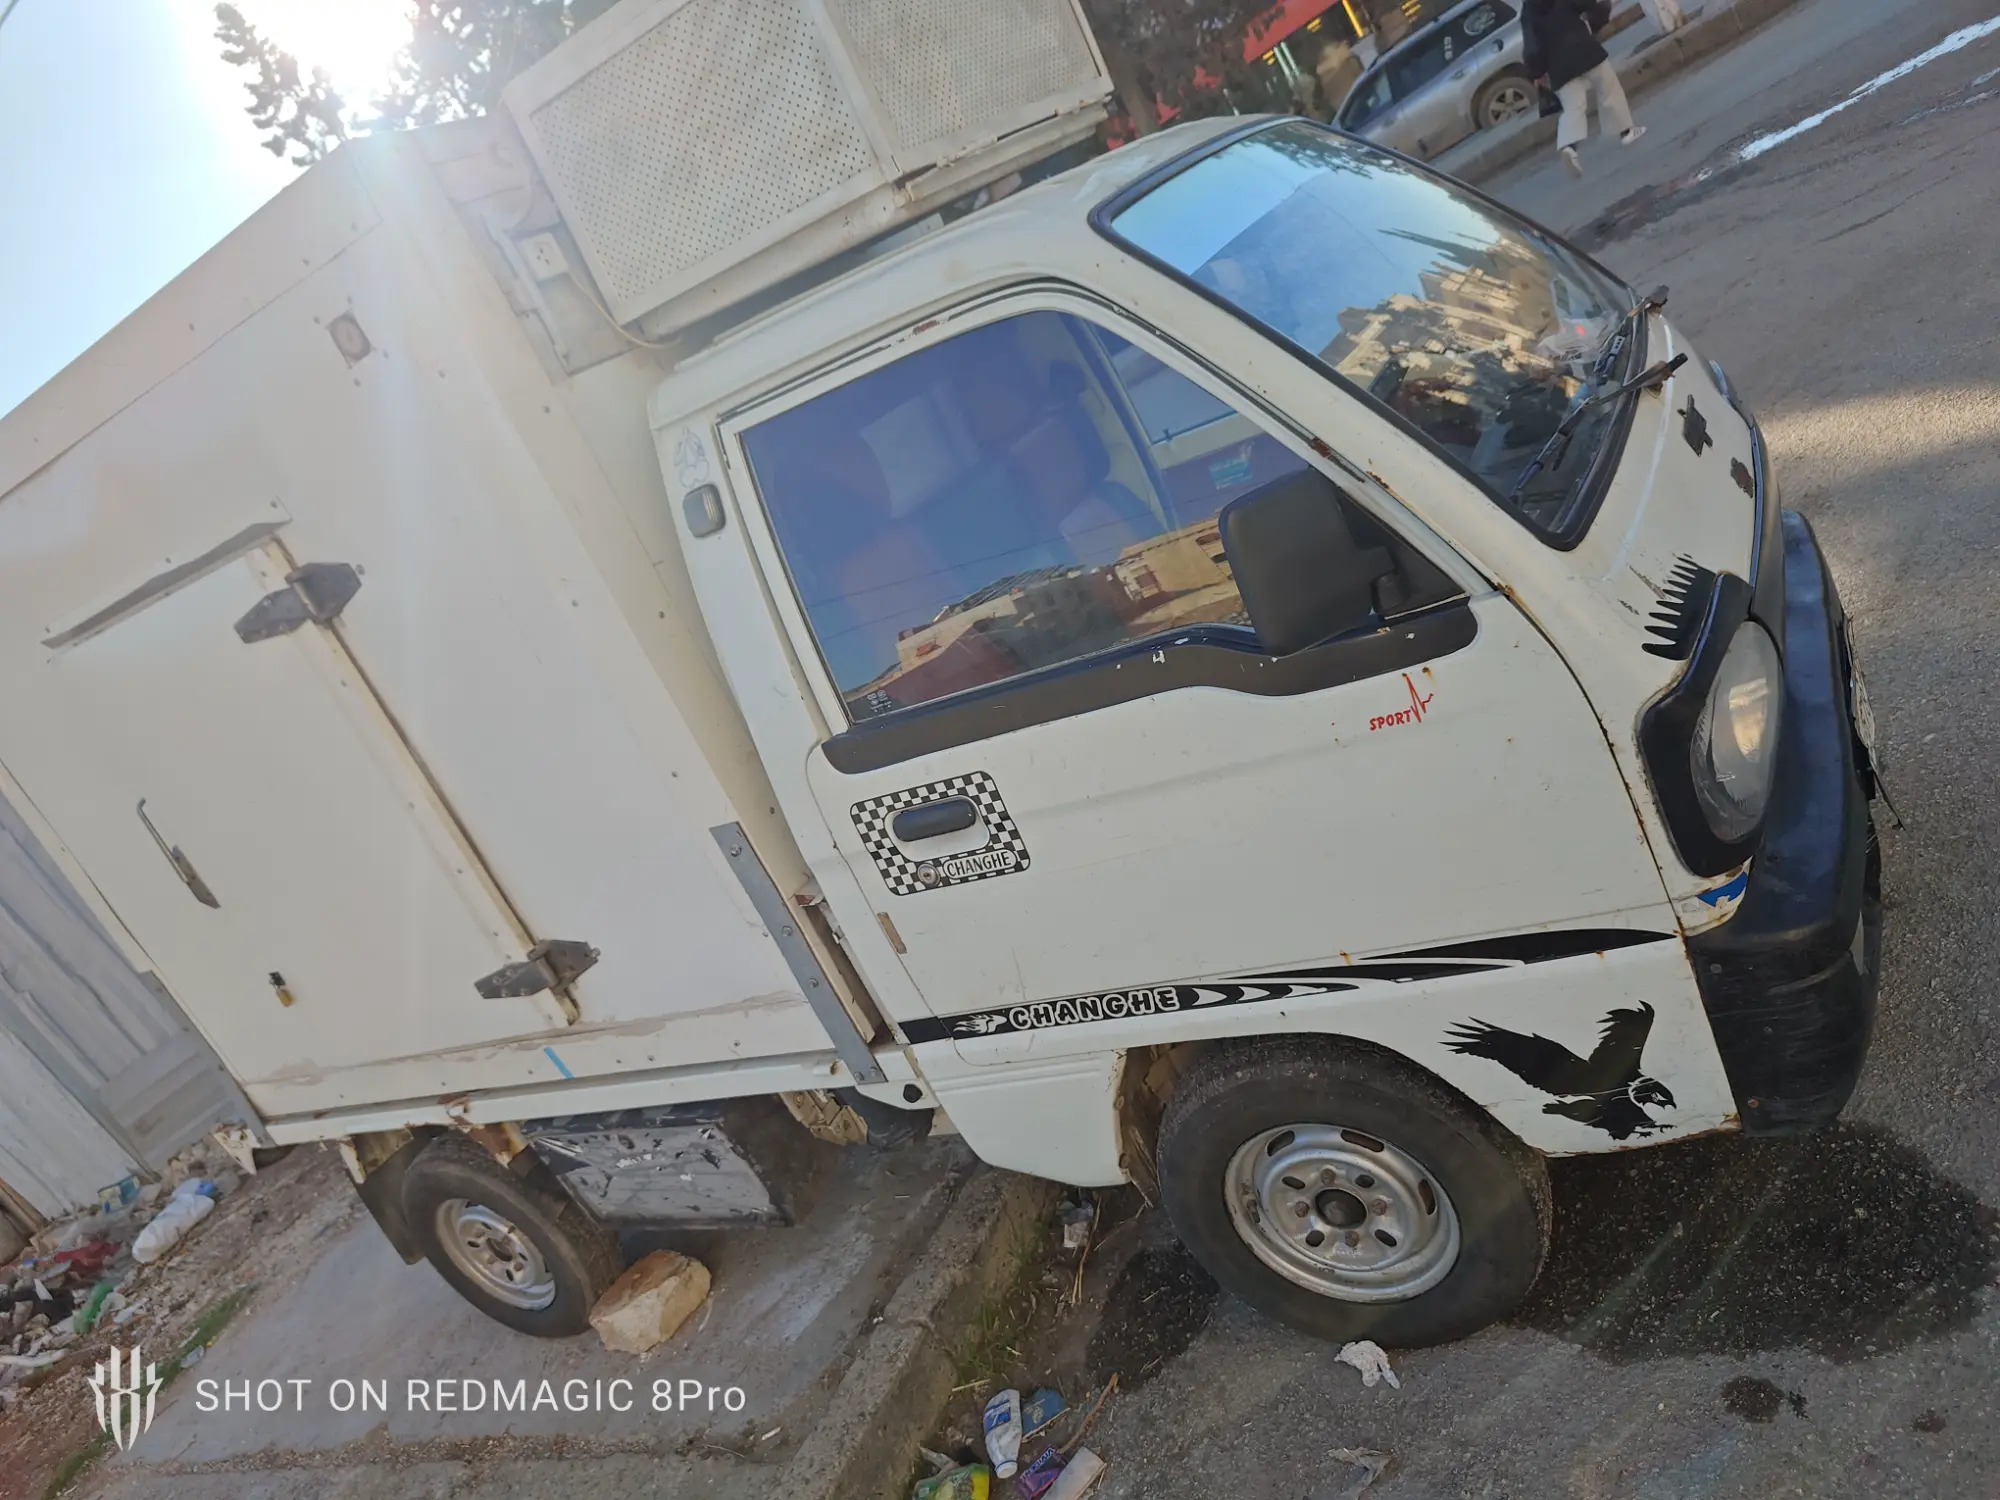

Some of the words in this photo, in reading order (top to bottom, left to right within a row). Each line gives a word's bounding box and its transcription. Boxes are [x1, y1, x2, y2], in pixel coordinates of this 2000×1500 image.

[1369, 709, 1411, 731] SPORT
[946, 850, 1012, 878] CHANGHE
[1009, 986, 1180, 1031] CHANGHE
